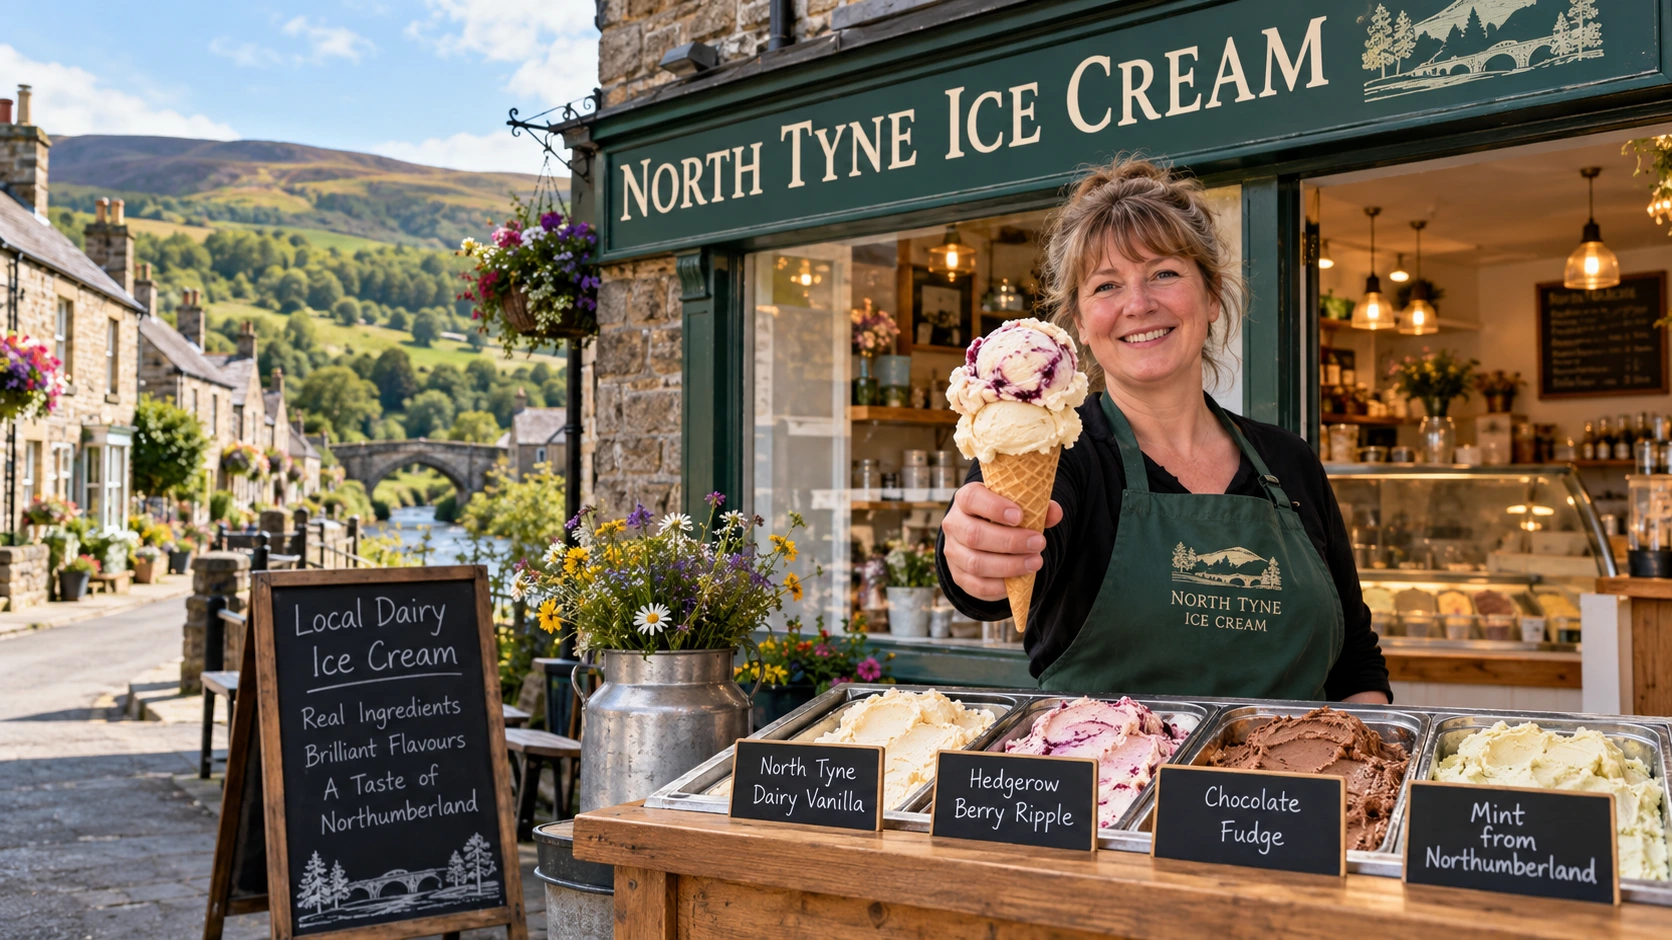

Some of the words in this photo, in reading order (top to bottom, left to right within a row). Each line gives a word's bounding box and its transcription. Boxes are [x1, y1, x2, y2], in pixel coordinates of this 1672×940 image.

[620, 142, 763, 221] NORTH
[780, 109, 917, 189] TYNE
[945, 82, 1041, 160] ICE
[1066, 15, 1329, 134] CREAM
[295, 597, 363, 636] Local
[375, 596, 446, 636] Dairy
[1171, 590, 1229, 610] NORTH
[1237, 597, 1281, 614] TYNE
[1184, 612, 1208, 626] ICE
[1215, 616, 1267, 631] CREAM
[313, 645, 354, 677] Ice
[368, 640, 458, 671] Cream
[301, 703, 345, 730] Real
[359, 695, 461, 730] Ingredients
[304, 738, 377, 768] Brilliant
[388, 732, 466, 756] Flavours
[323, 777, 339, 801] A
[350, 770, 406, 795] Taste
[419, 763, 439, 786] of
[760, 756, 807, 778] North
[815, 758, 857, 788] Tyne
[969, 768, 1060, 799] Hedgerow
[321, 788, 479, 835] Northumberland
[752, 785, 798, 816] Dairy
[806, 788, 865, 814] Vanilla
[954, 798, 1005, 831] Berry
[1015, 802, 1074, 833] Ripple
[1204, 786, 1302, 813] Chocolate
[1470, 802, 1525, 826] Mint
[1220, 820, 1285, 855] Fudge
[1480, 825, 1536, 852] from
[1425, 846, 1598, 886] Northumberland
